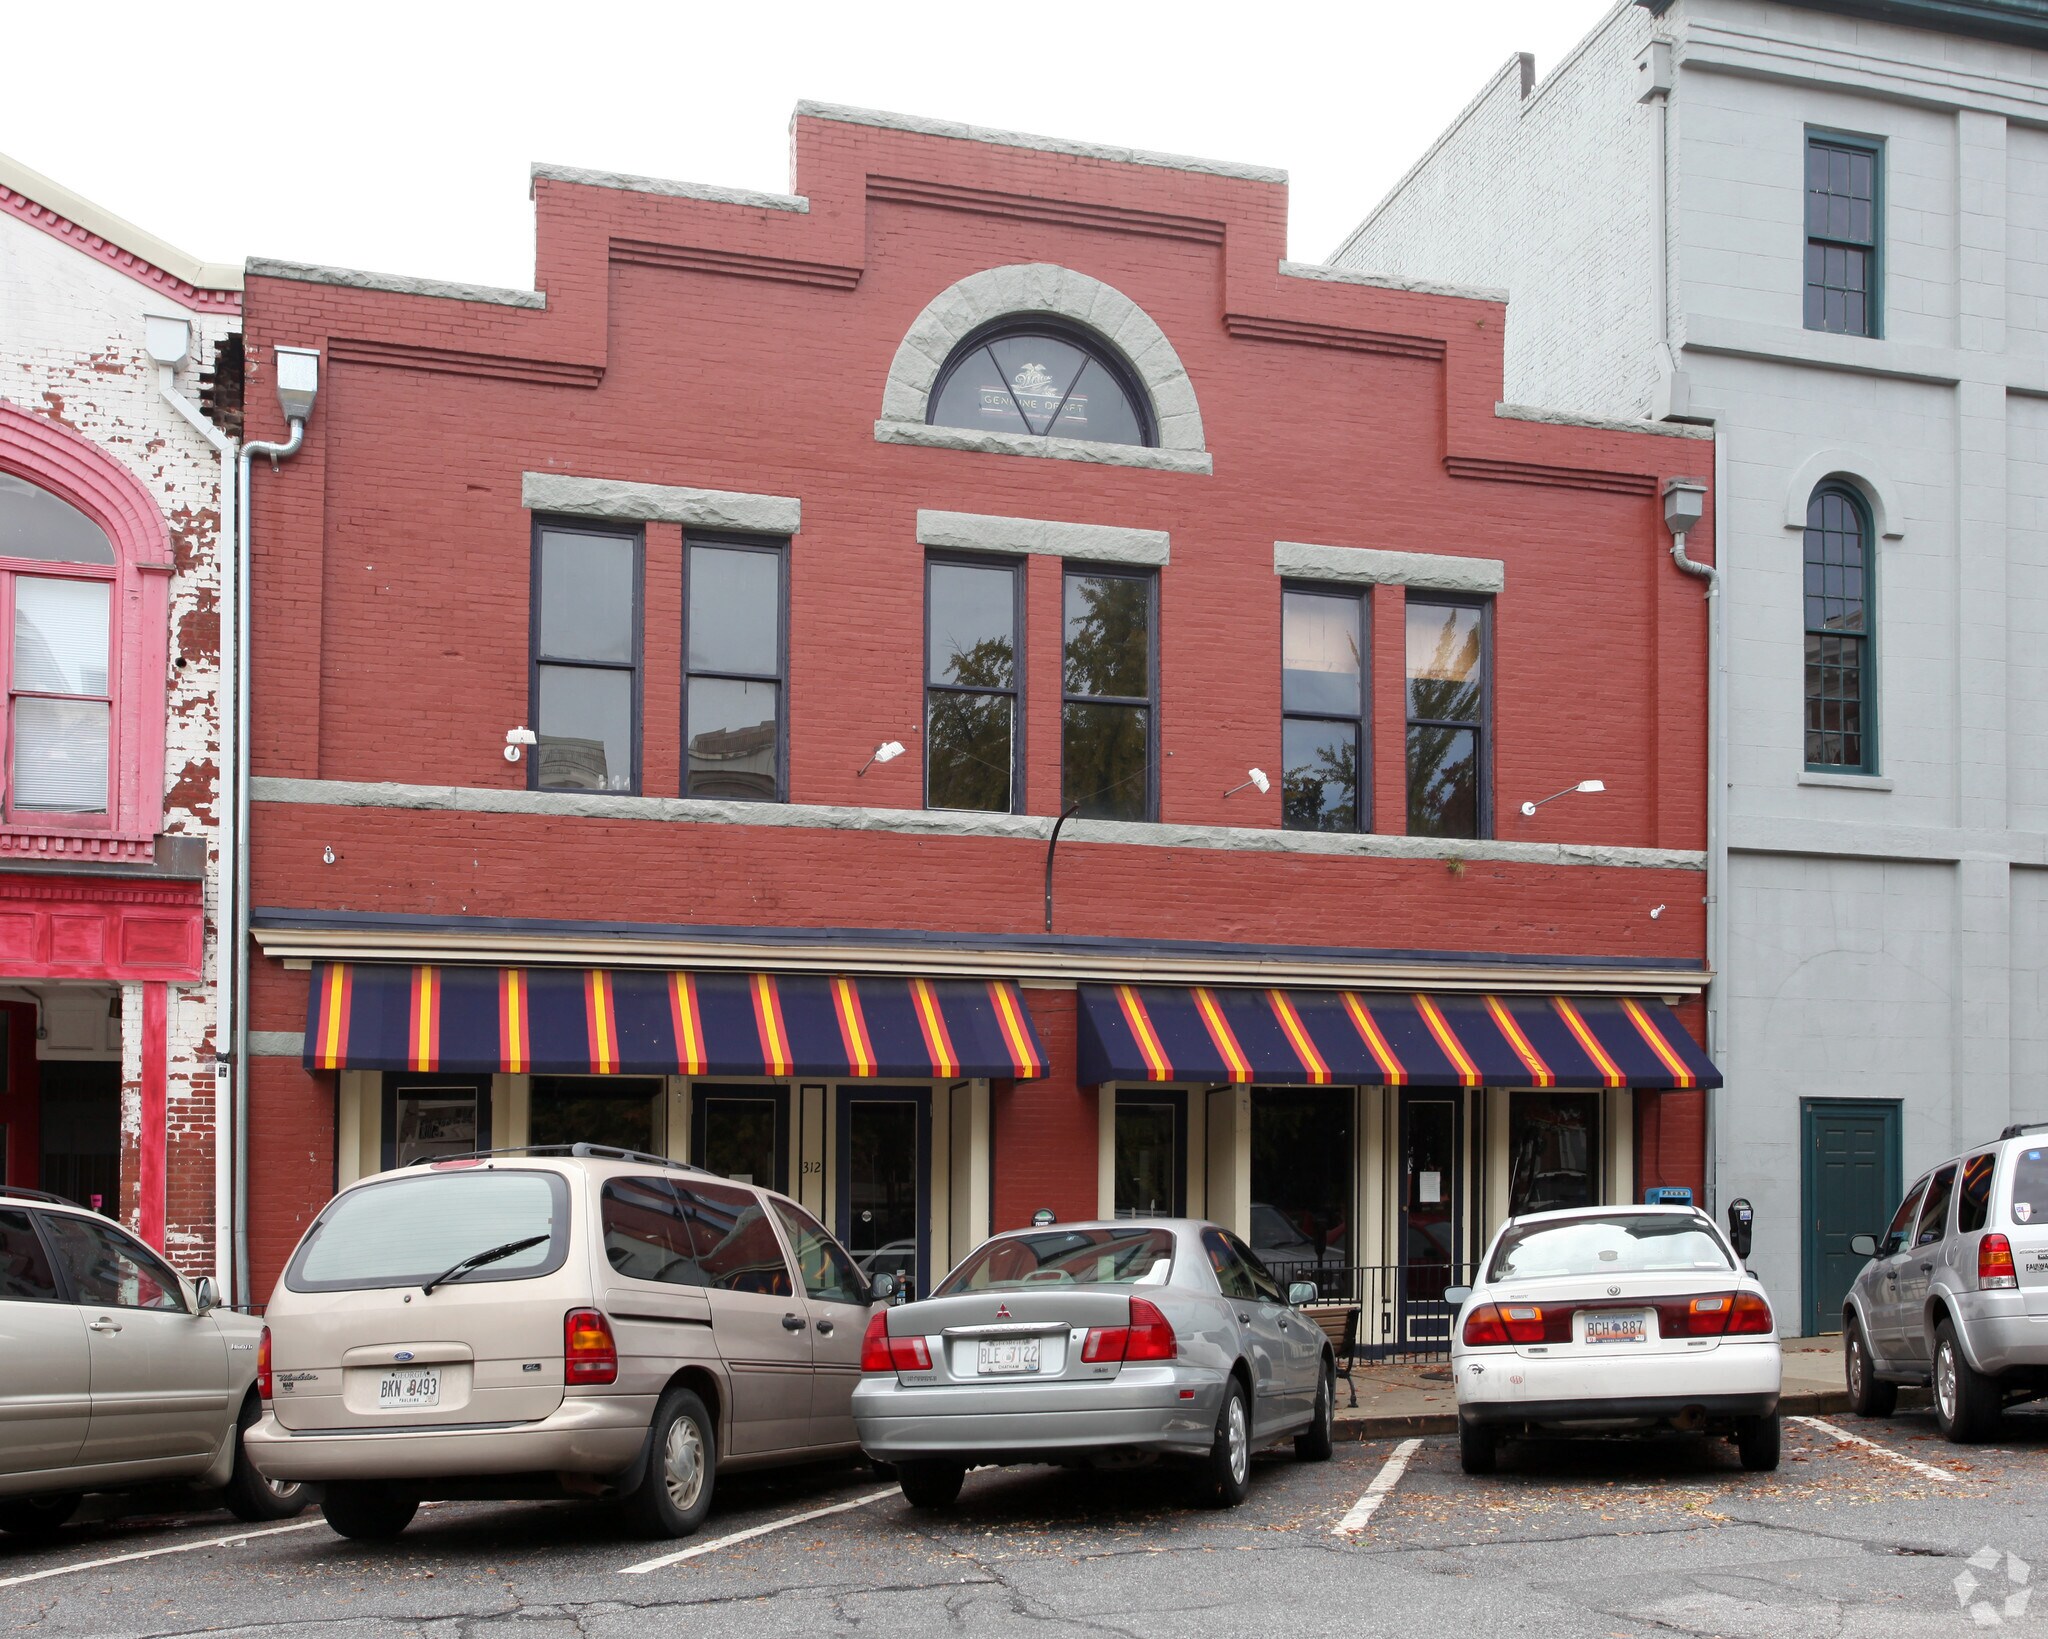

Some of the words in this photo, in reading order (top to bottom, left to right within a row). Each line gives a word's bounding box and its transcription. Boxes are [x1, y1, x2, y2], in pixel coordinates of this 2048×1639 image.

[802, 1161, 821, 1174] 312
[1588, 1322, 1609, 1336] BCH
[1622, 1320, 1642, 1334] 887
[981, 1348, 1000, 1364] BLE
[1010, 1346, 1037, 1363] 7122
[394, 1370, 428, 1379] GEORGIA
[380, 1379, 402, 1398] BKN
